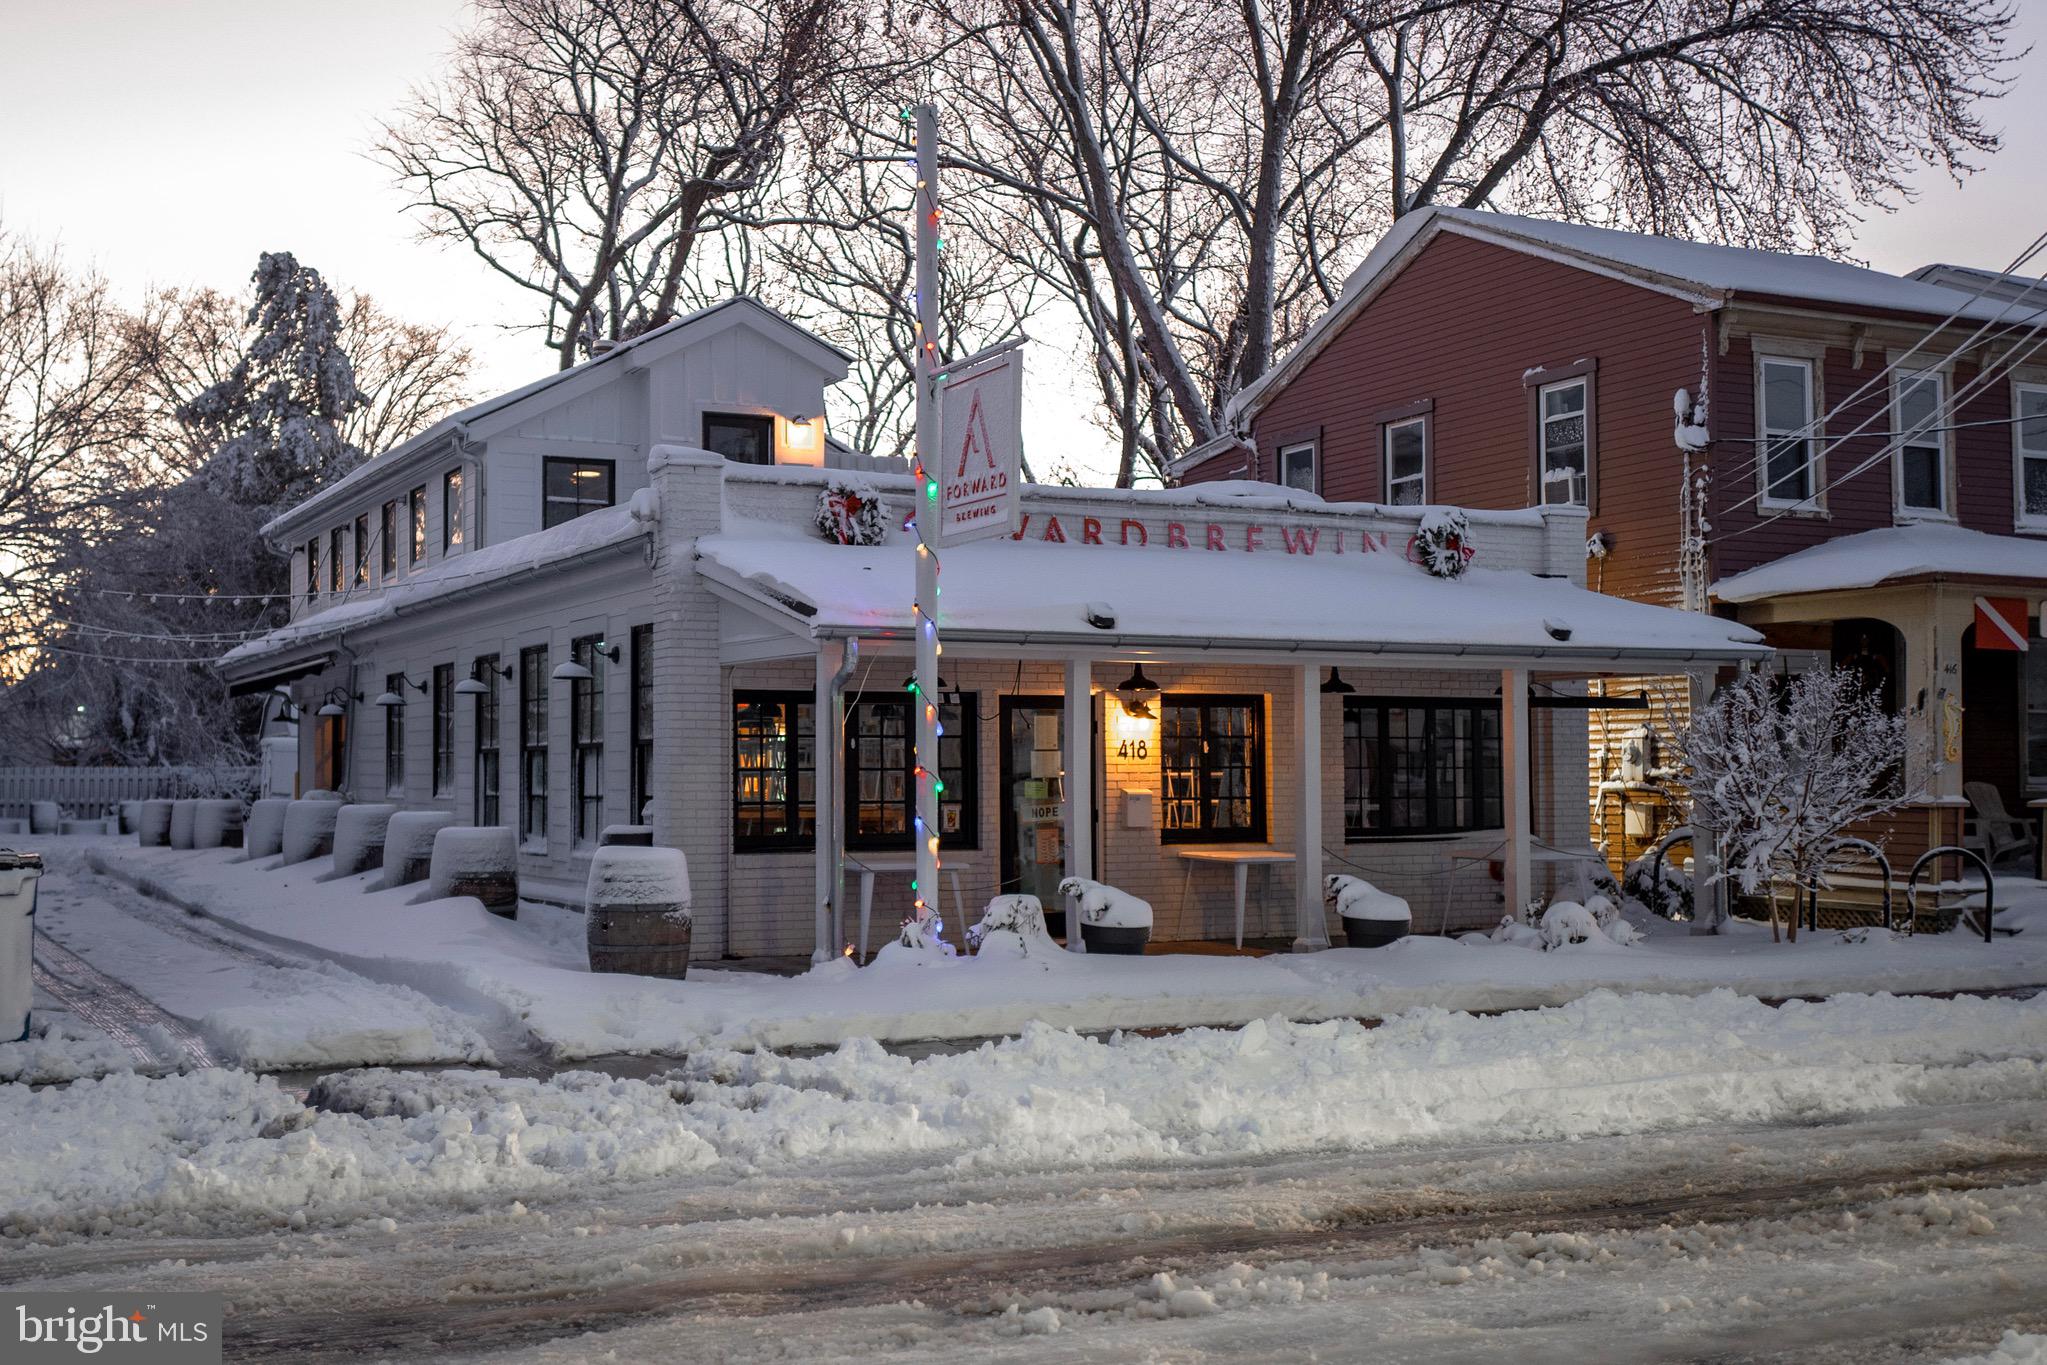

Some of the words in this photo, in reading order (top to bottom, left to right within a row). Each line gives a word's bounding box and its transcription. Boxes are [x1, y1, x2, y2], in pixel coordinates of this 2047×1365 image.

[946, 471, 1007, 500] FORWARD
[956, 505, 996, 522] BREWING
[1118, 739, 1147, 760] 418
